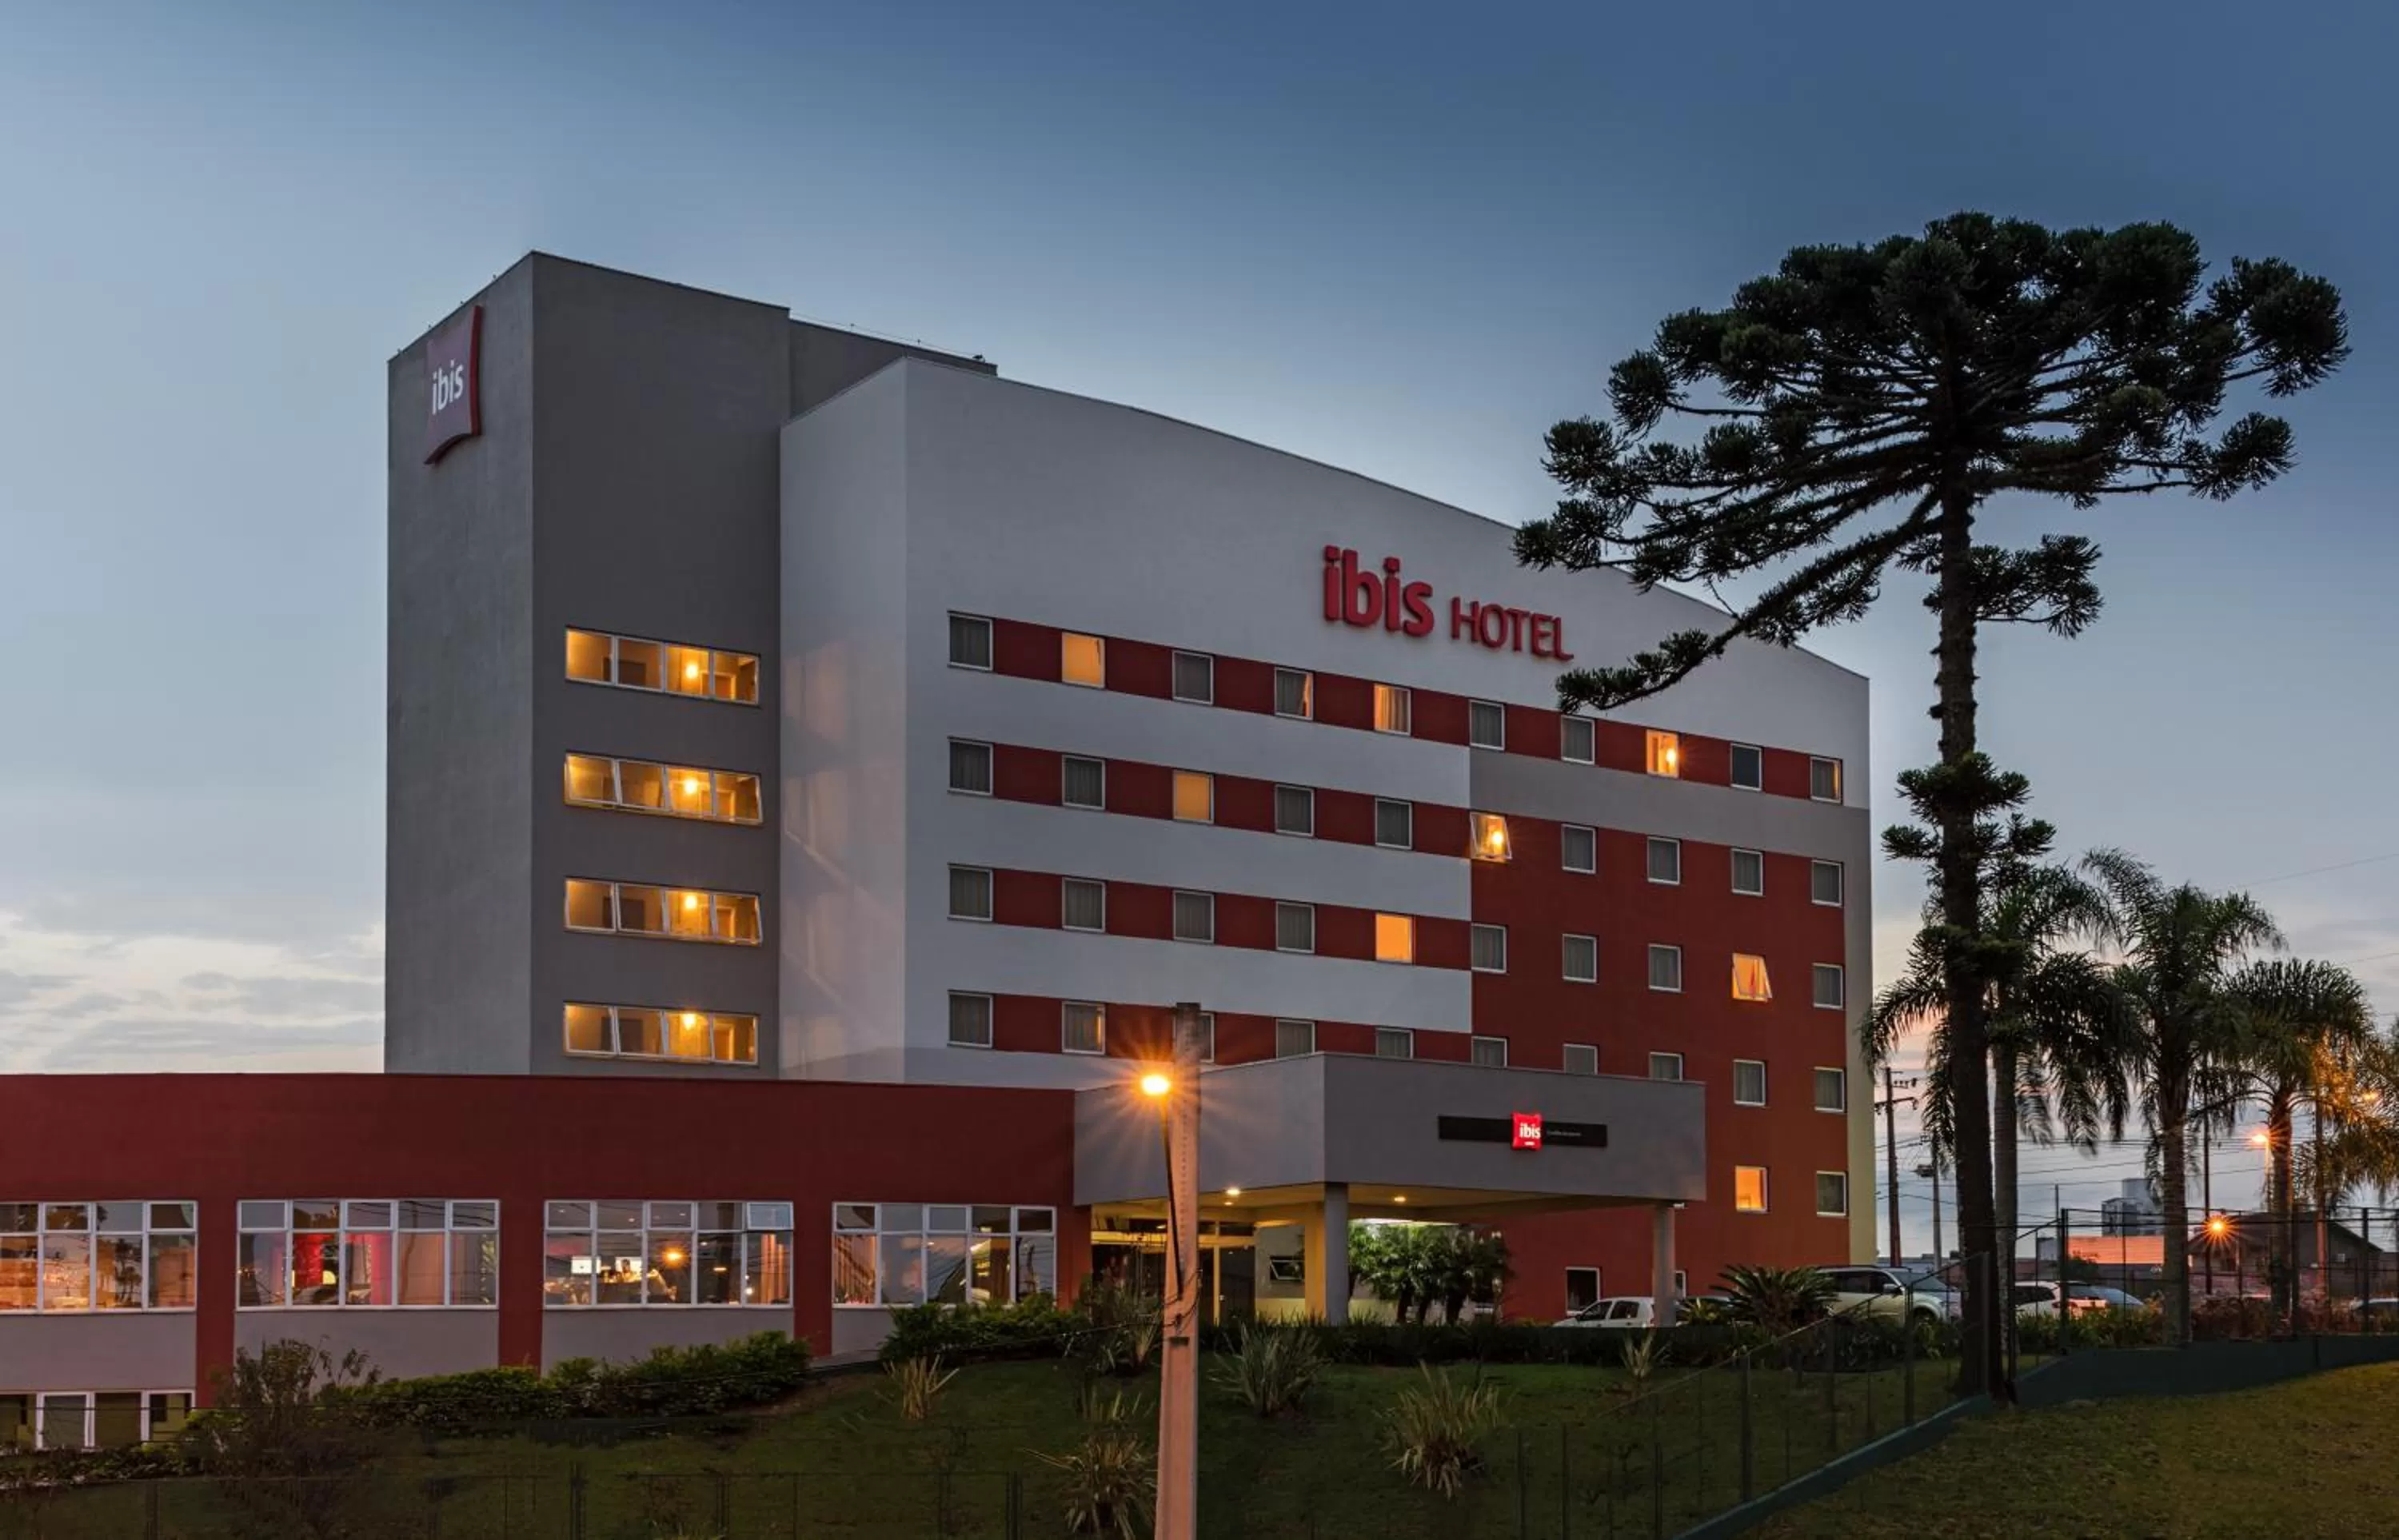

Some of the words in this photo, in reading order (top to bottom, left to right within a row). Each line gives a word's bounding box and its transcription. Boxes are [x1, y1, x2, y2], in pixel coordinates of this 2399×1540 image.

[432, 359, 463, 415] ibis
[1323, 545, 1434, 637] ibis
[1451, 596, 1574, 661] HOTEL
[1520, 1123, 1541, 1139] ibis
